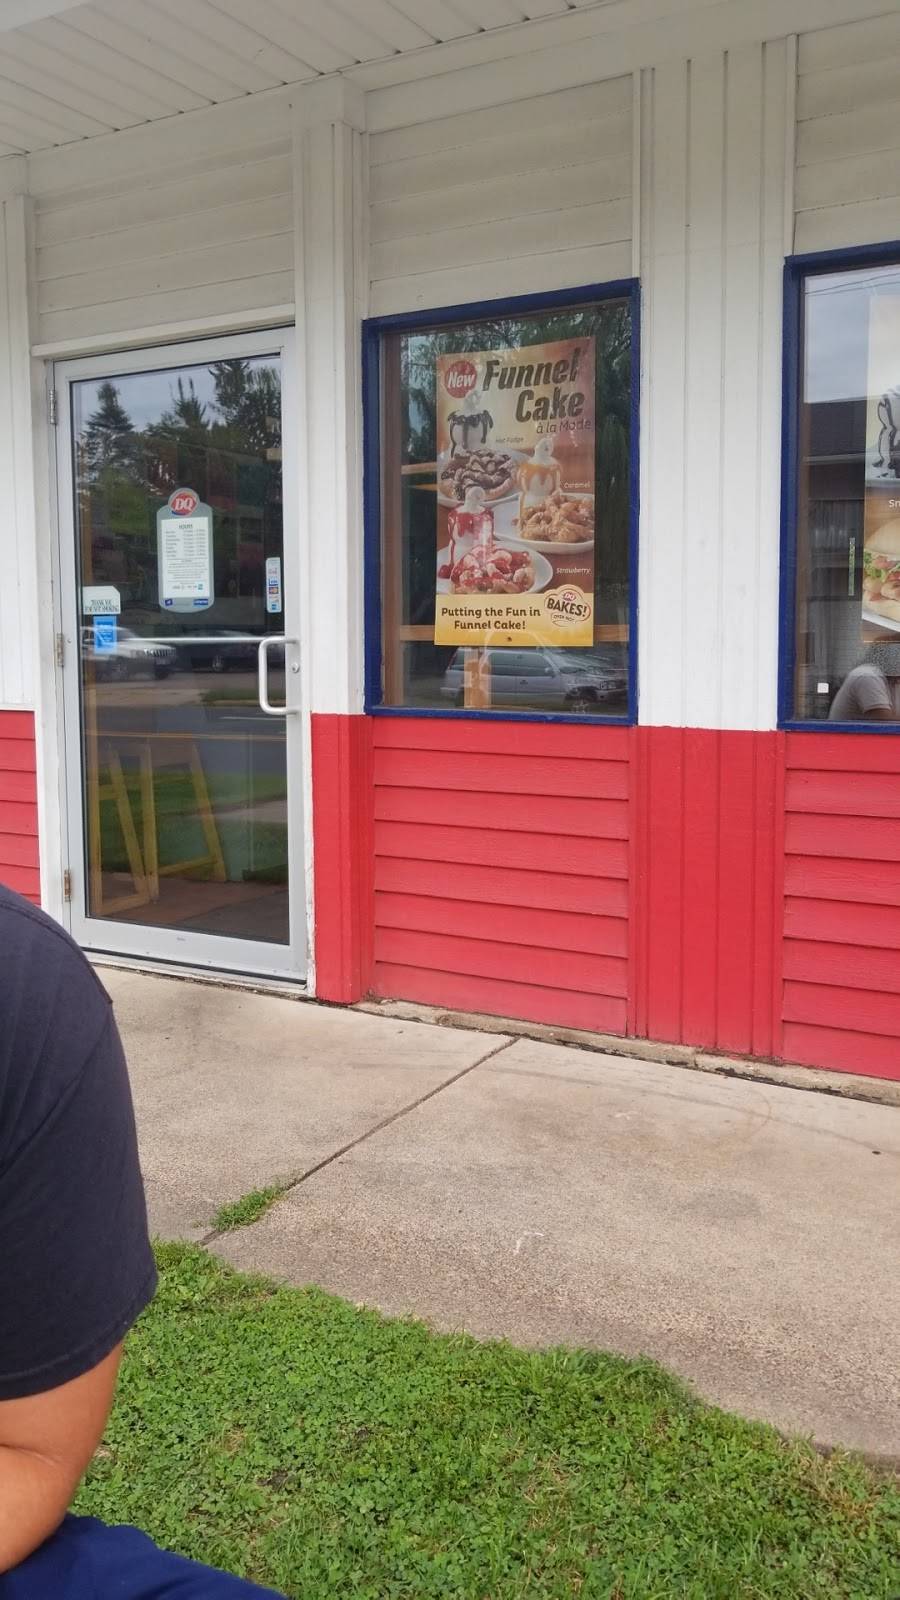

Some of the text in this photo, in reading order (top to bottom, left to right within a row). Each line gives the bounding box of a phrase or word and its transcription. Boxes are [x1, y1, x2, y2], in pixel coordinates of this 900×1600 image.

[482, 348, 581, 391] Funnel
[447, 371, 475, 388] New
[515, 387, 585, 422] Cake
[536, 418, 592, 434] à la Mode
[564, 481, 591, 489] Caramel
[174, 497, 194, 511] DQ
[556, 567, 591, 576] Strawberry
[441, 607, 541, 618] Putting the Fun in
[547, 597, 587, 617] BAKES!
[454, 620, 526, 630] Funnel Cake!
